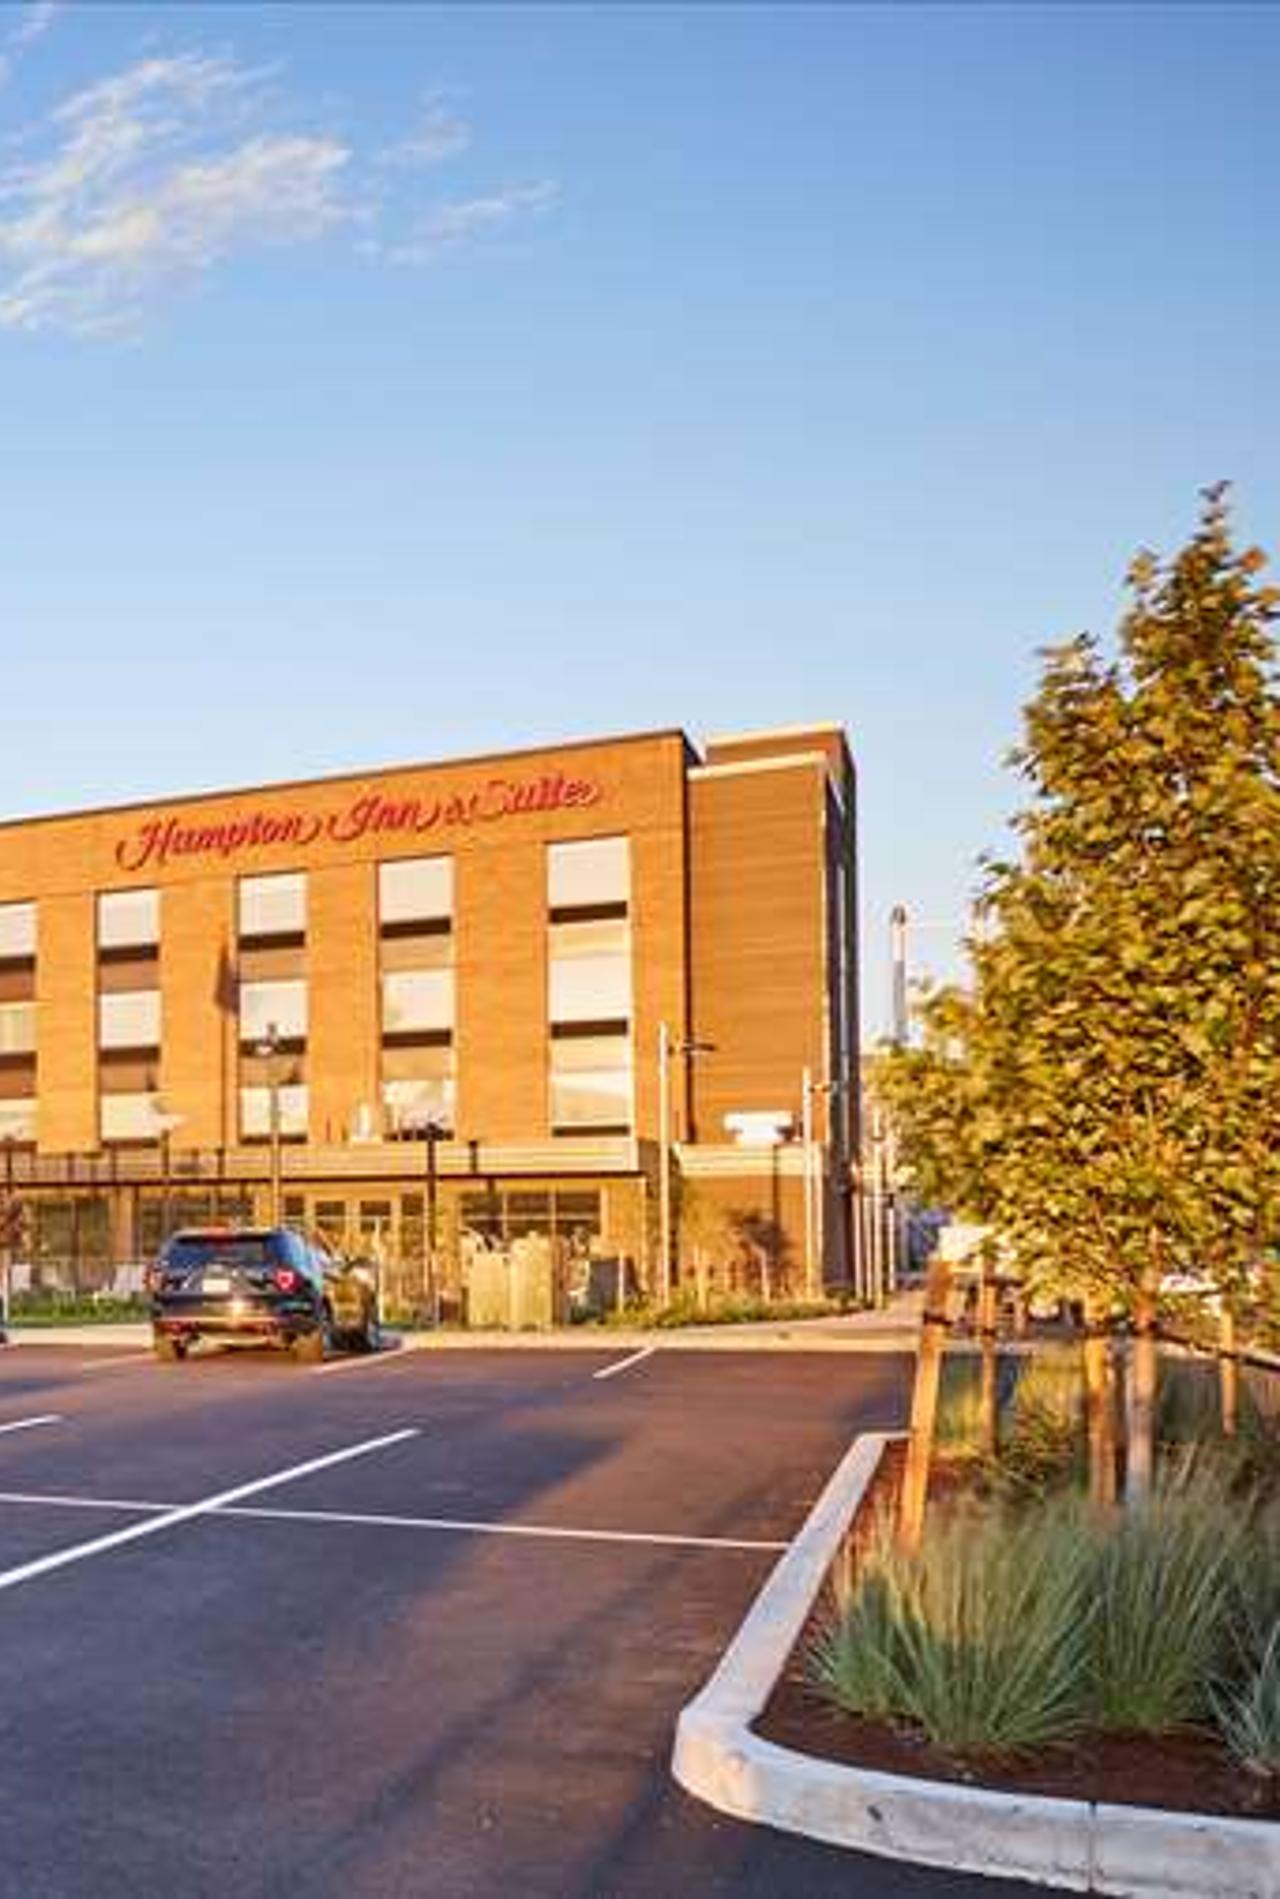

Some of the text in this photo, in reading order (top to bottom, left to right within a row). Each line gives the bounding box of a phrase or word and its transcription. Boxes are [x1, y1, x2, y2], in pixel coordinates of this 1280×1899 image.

[115, 811, 321, 871] Hampton
[326, 796, 440, 841] Inn
[480, 774, 602, 822] Suites
